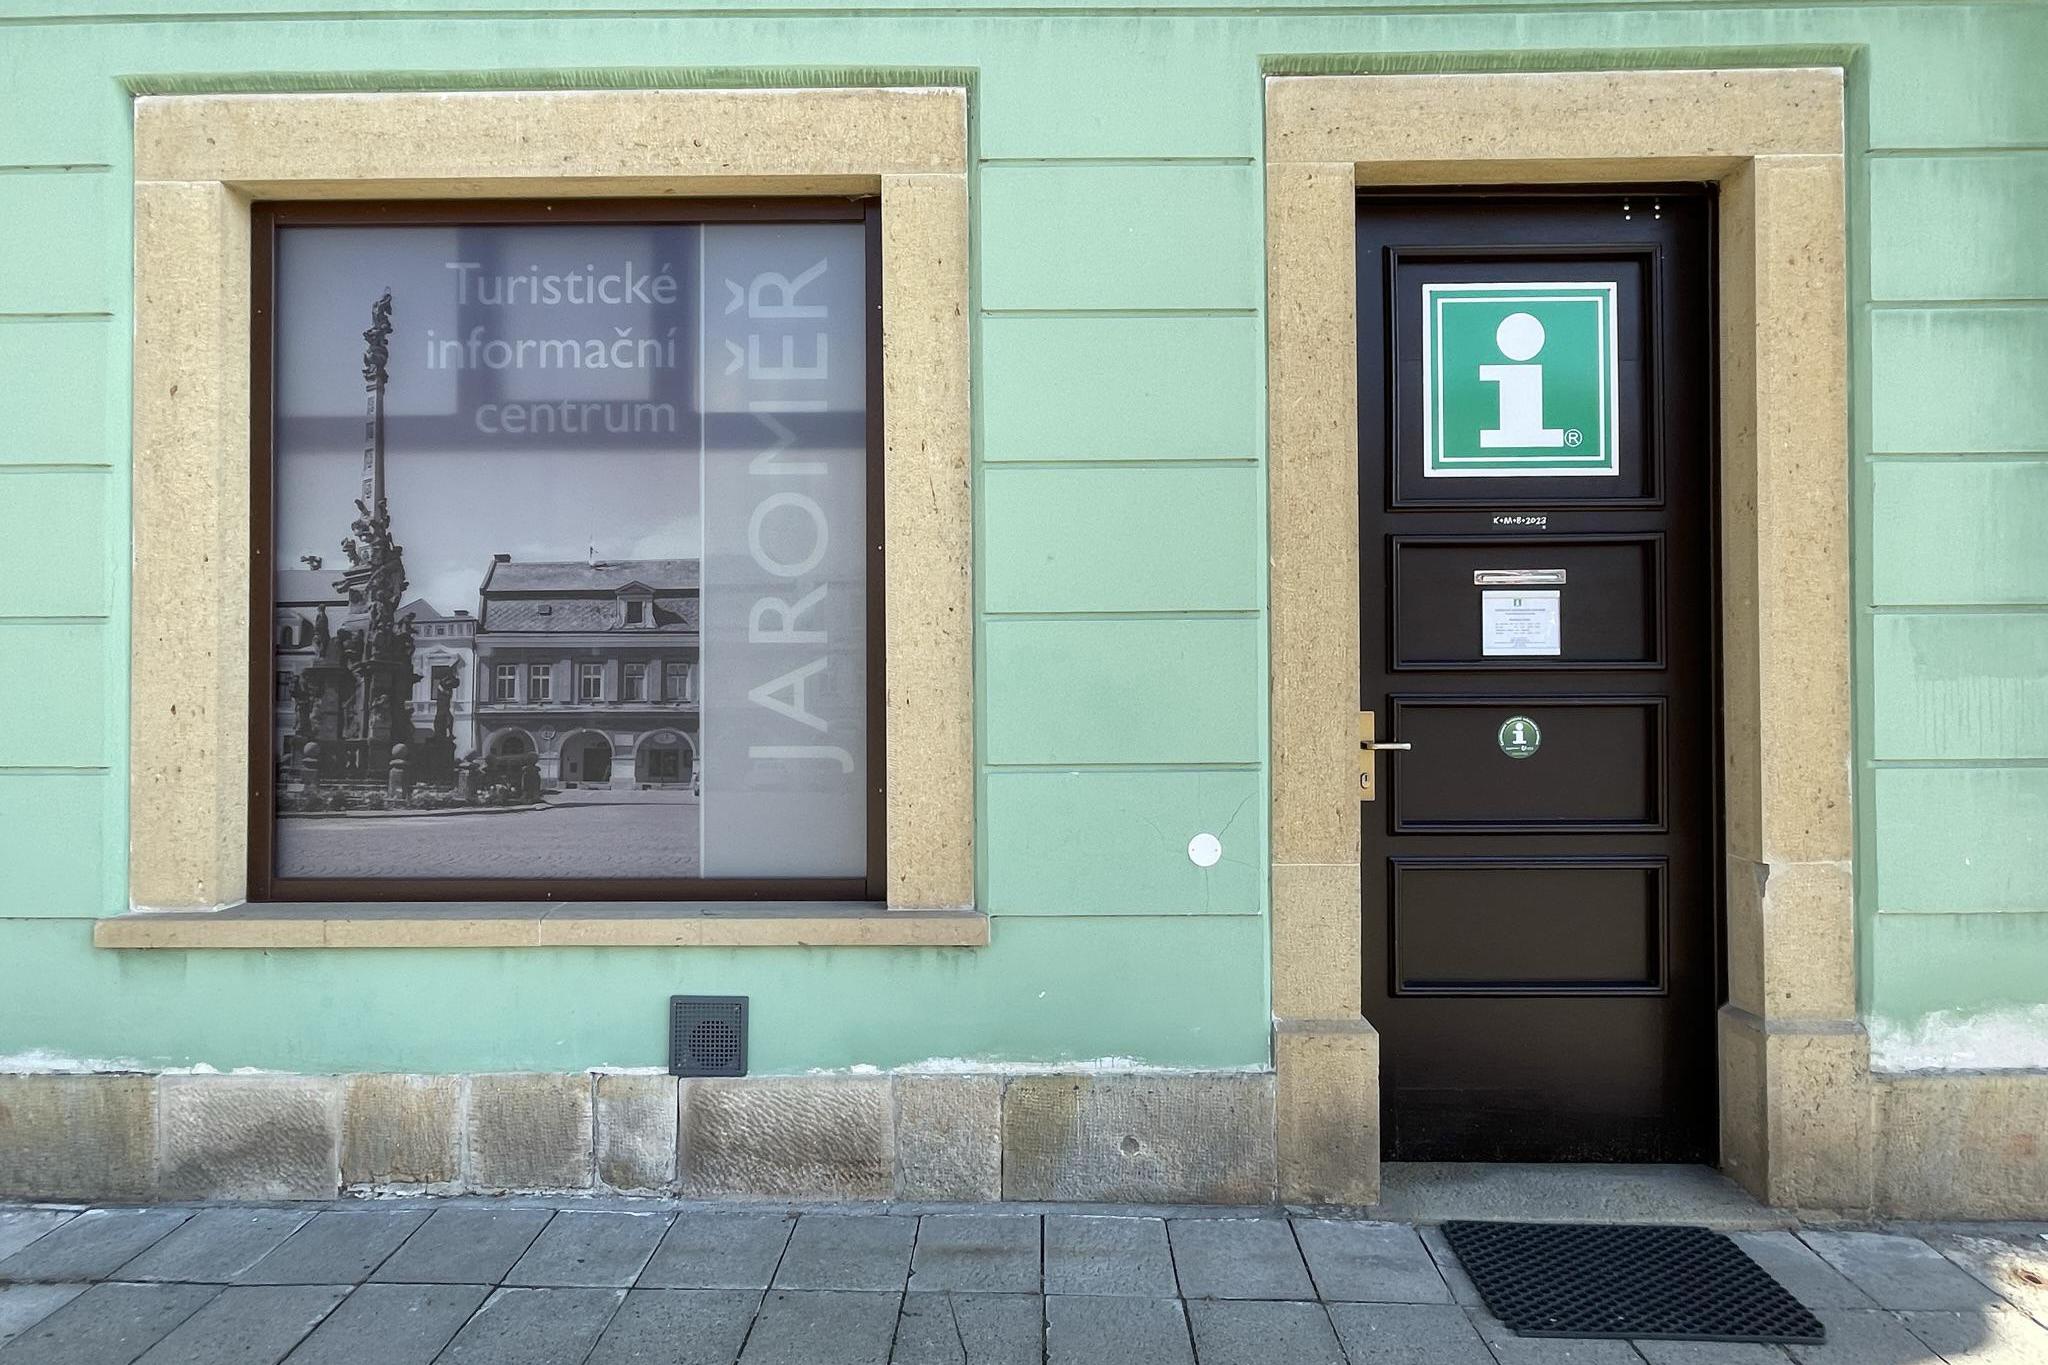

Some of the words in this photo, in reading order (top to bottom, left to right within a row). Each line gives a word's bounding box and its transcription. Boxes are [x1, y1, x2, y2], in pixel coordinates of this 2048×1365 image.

[445, 260, 679, 305] Turistické
[426, 325, 678, 369] informační
[474, 399, 678, 434] centrum
[724, 256, 855, 776] JAROMĚŘ
